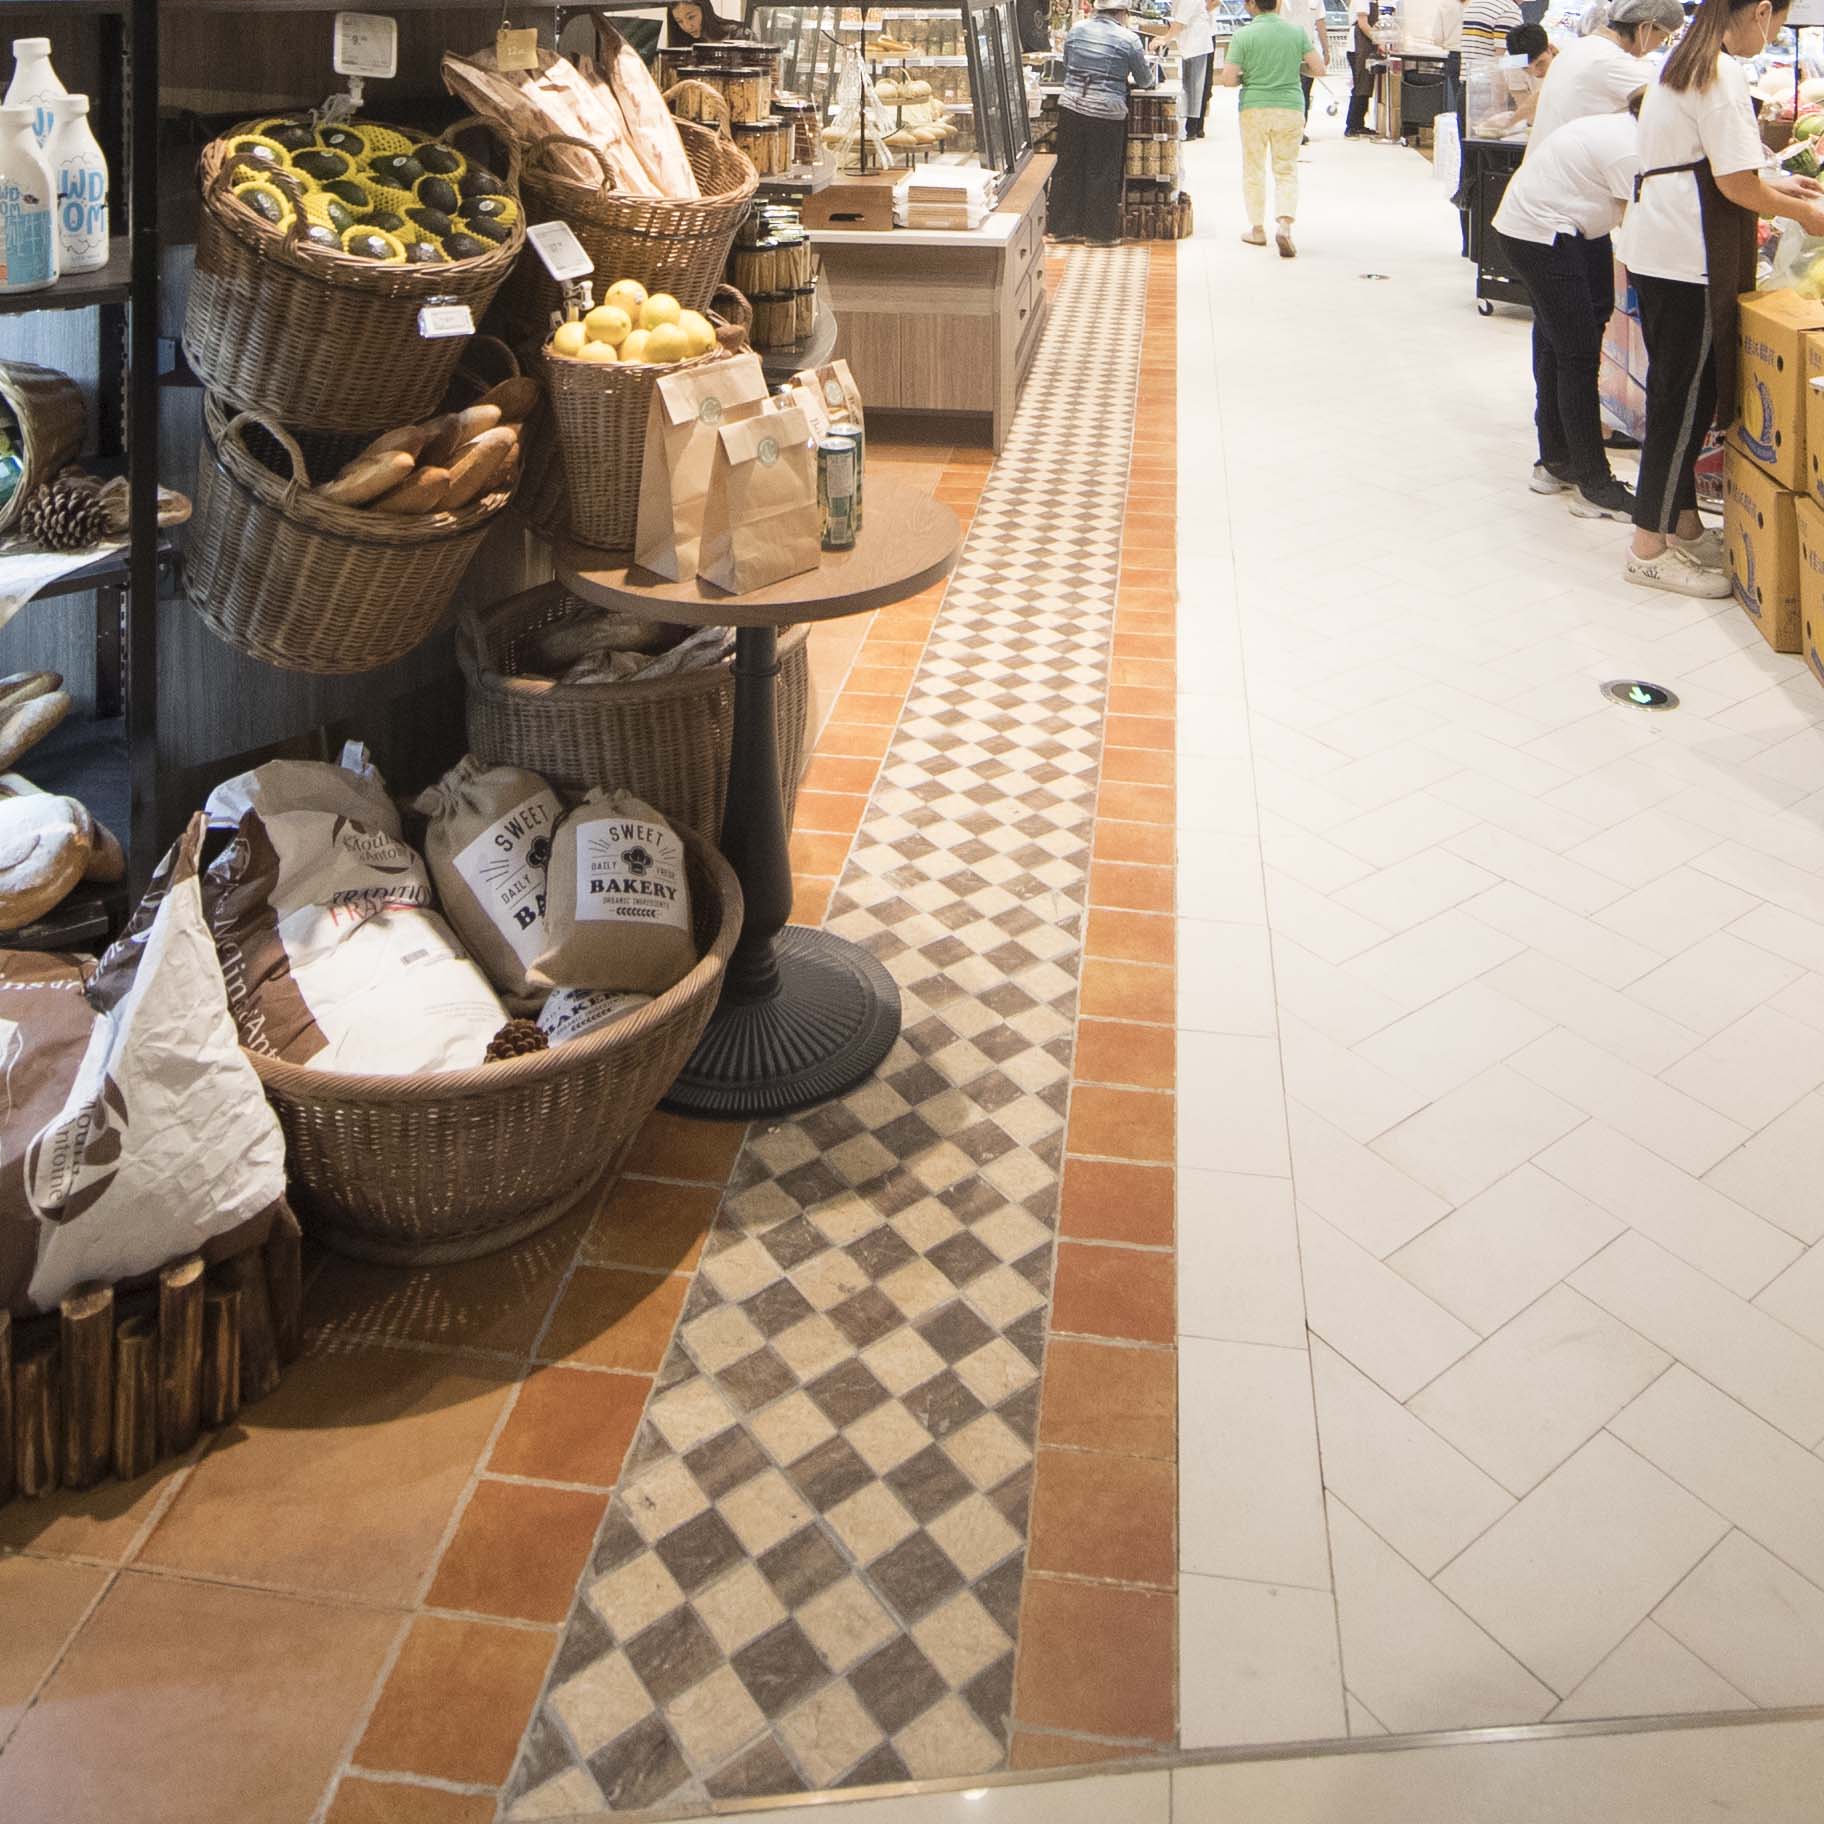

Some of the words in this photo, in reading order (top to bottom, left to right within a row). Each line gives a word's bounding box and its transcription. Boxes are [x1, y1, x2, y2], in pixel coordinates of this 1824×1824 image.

[494, 803, 549, 853] SWEET
[608, 823, 664, 847] SWEET
[591, 860, 618, 871] DAILY
[501, 873, 532, 905] DAILY
[589, 878, 678, 901] BAKERY
